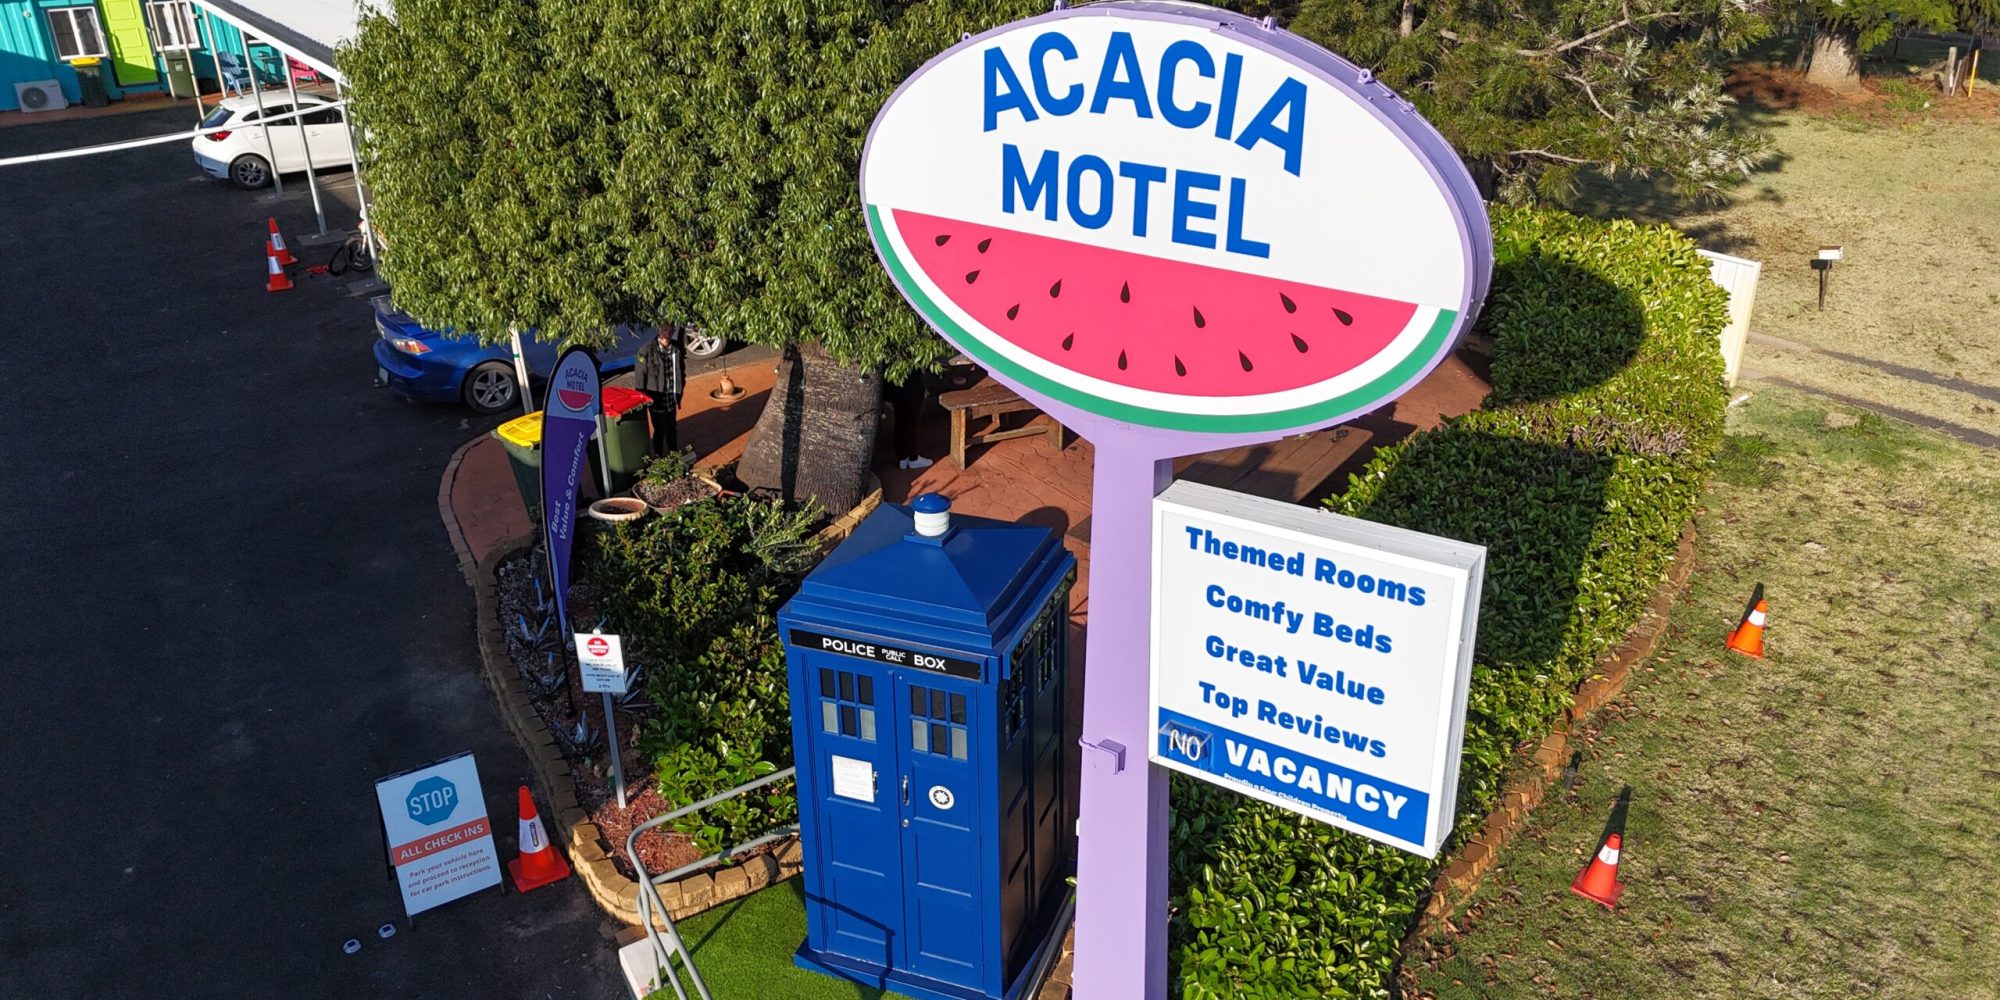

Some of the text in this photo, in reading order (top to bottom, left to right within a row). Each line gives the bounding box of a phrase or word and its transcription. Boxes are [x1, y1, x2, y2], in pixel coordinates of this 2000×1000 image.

[983, 31, 1308, 177] ACACIA
[1001, 143, 1271, 260] MOTEL
[565, 367, 588, 383] ACACIA
[566, 380, 585, 391] MOTEL
[559, 431, 584, 540] Value & Comfort
[551, 500, 562, 533] Best
[1185, 525, 1426, 606] Themed Rooms
[1205, 584, 1393, 654] Comfy Beds
[822, 637, 946, 671] POLICE BOX
[881, 648, 906, 658] PUBLIC
[885, 654, 902, 663] CALL
[1205, 635, 1385, 705] Great Value
[1198, 681, 1387, 759] Top Reviews
[1170, 729, 1408, 820] NO VACANCY
[410, 786, 453, 816] STOP
[1278, 791, 1311, 808] Children
[400, 824, 484, 860] ALL CHECK INS
[407, 855, 491, 889] and proceed to reception
[409, 848, 484, 878] Park your vehicle here
[410, 864, 493, 897] for car park instructions.
